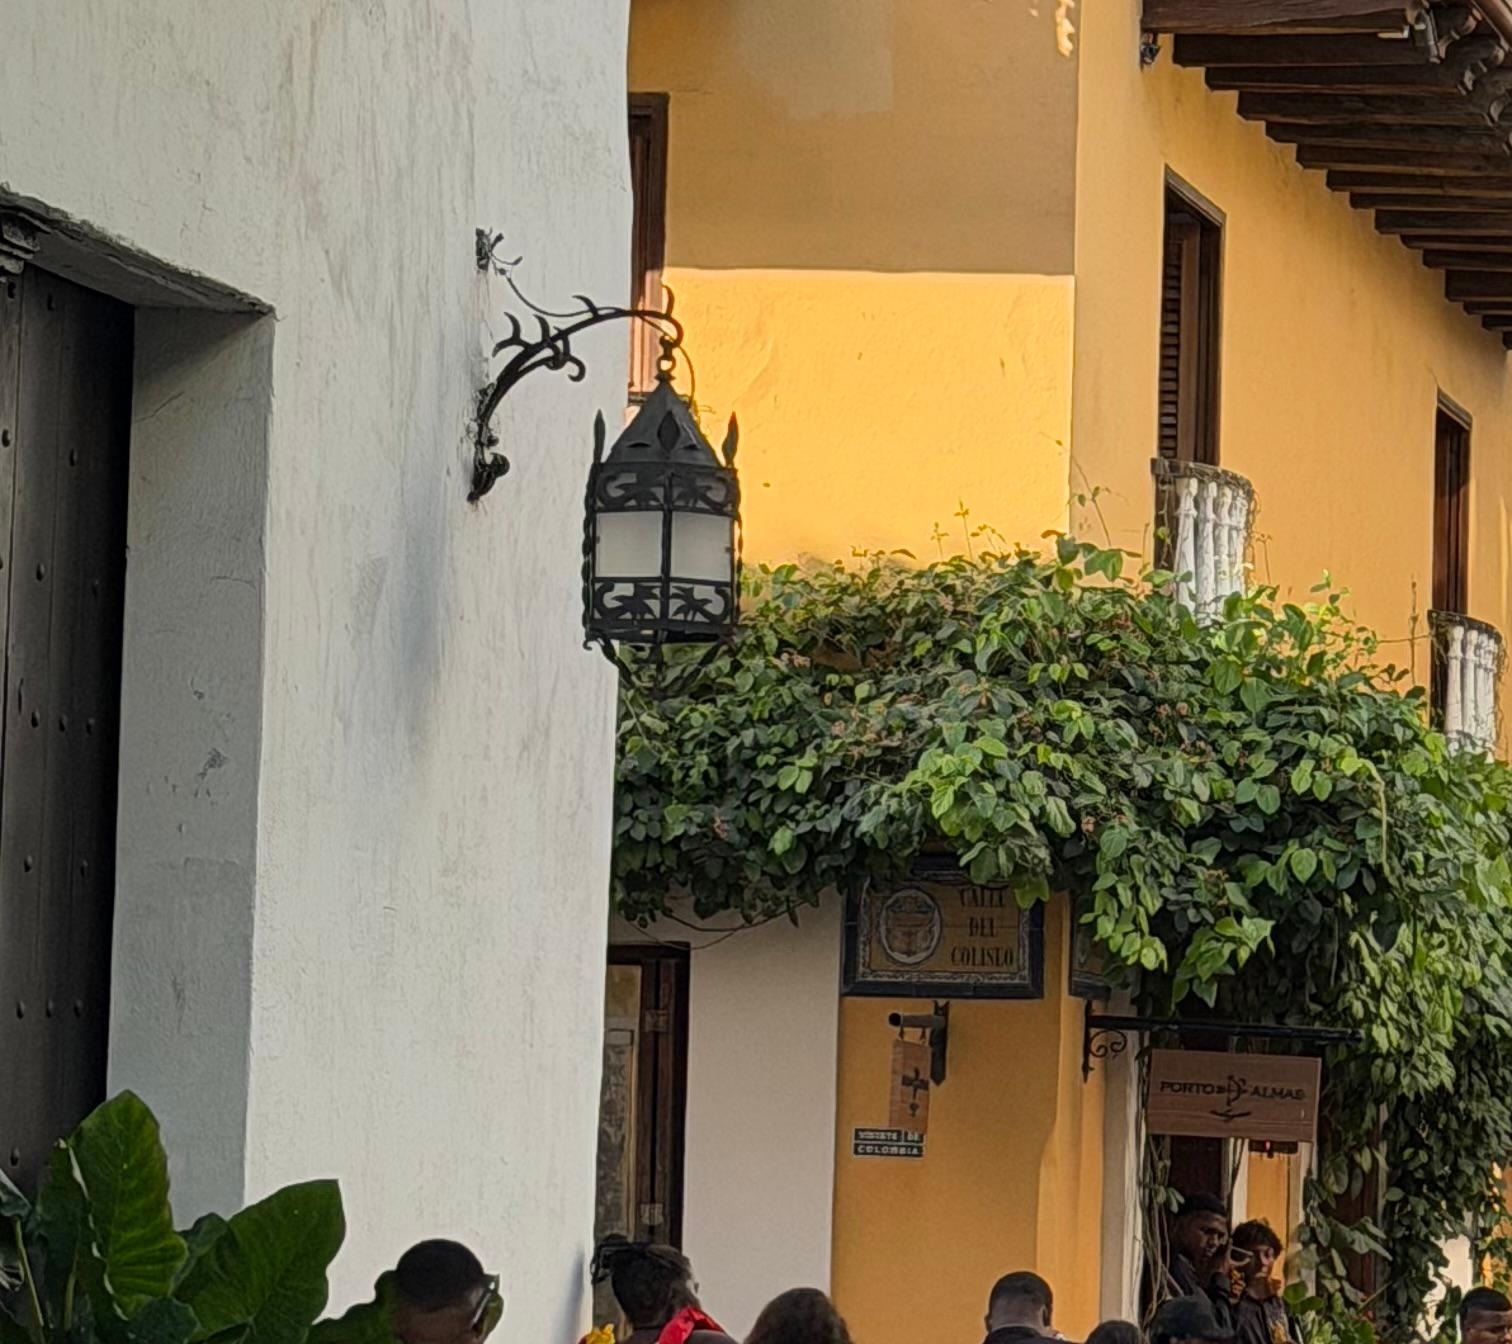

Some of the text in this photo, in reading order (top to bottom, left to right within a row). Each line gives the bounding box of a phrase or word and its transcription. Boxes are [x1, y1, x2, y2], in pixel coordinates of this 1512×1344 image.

[960, 887, 1005, 907] CALLE
[969, 917, 997, 937] DEL
[951, 946, 1014, 967] COLISEO
[1160, 1081, 1214, 1095] PORTO
[1251, 1086, 1305, 1100] ALMAS
[857, 1145, 920, 1156] COLOMBIA
